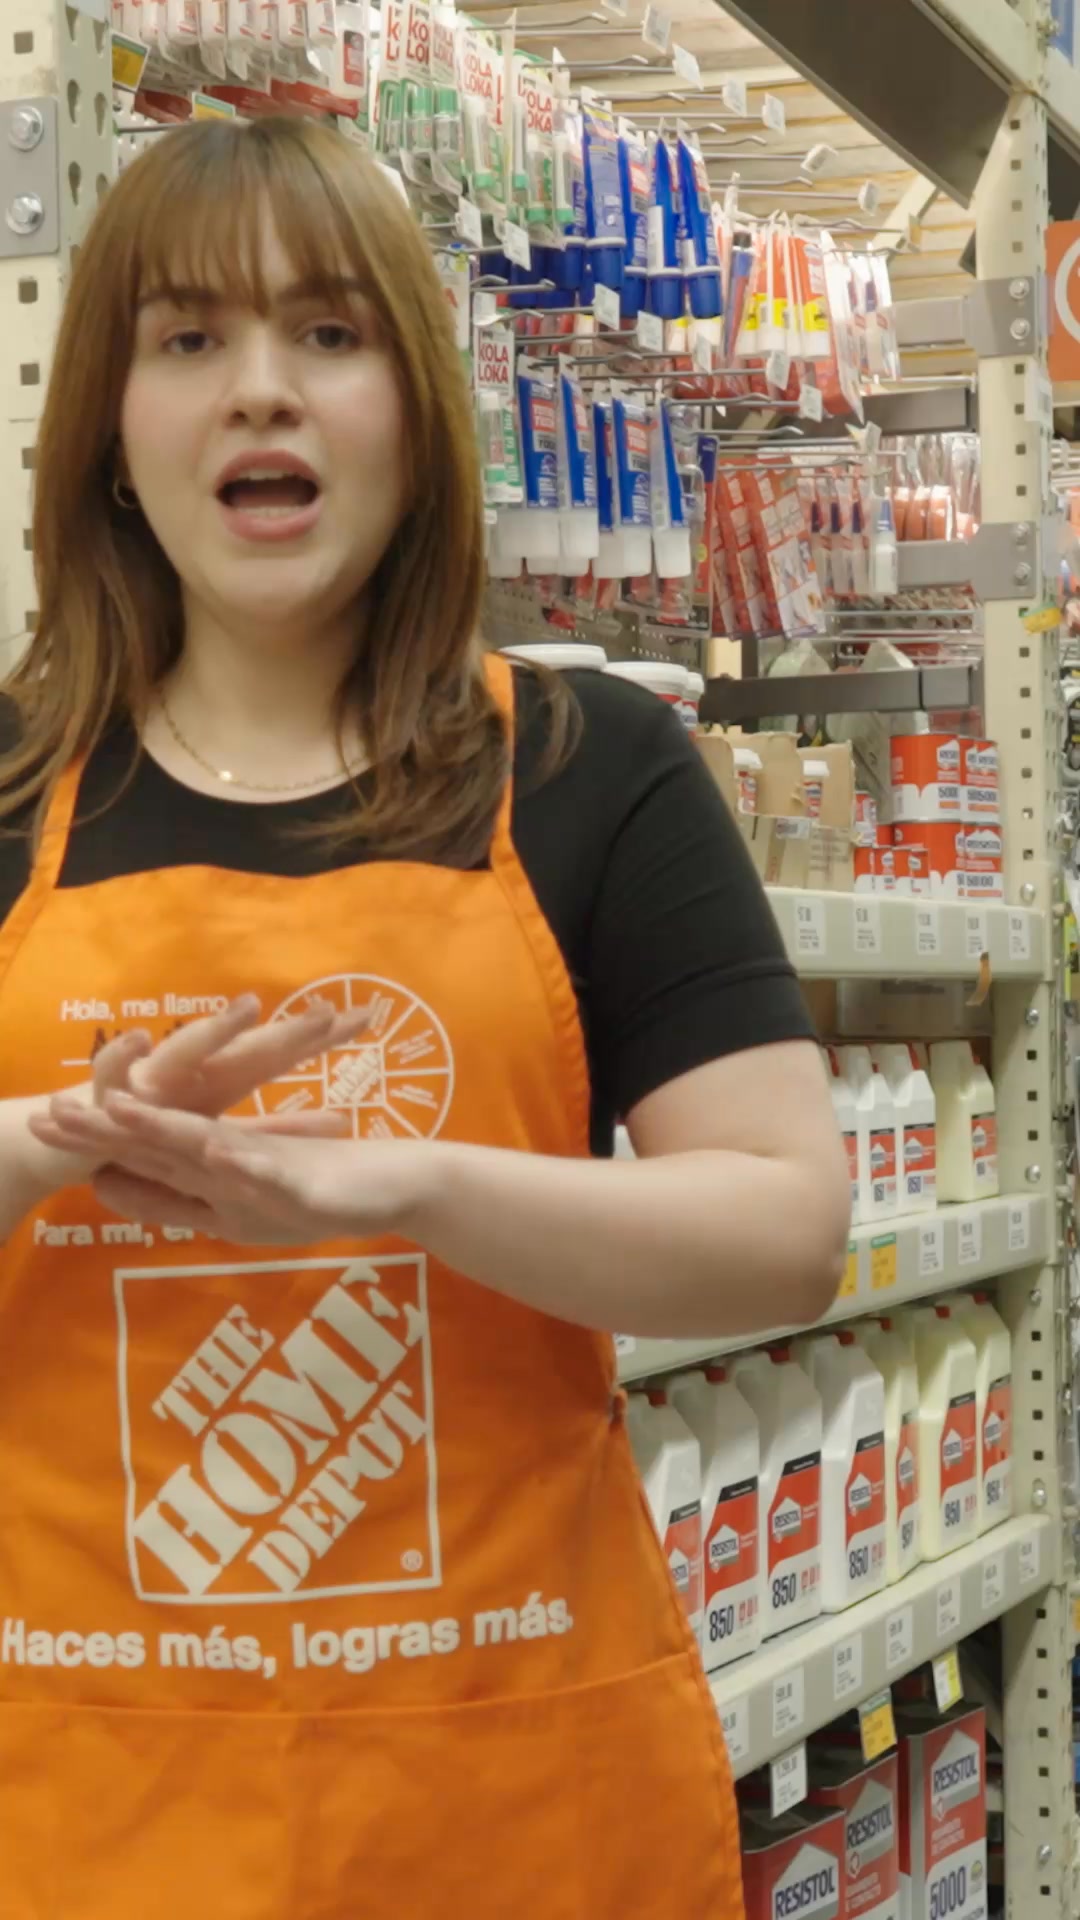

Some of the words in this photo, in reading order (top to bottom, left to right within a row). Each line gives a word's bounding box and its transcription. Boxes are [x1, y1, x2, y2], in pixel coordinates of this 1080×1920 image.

[527, 110, 552, 134] OKA
[478, 337, 509, 364] KOLA
[478, 363, 509, 384] LOKA
[60, 998, 116, 1022] Hola,
[122, 998, 159, 1018] me
[164, 993, 229, 1016] llamo
[34, 1218, 93, 1246] Para
[151, 1304, 275, 1437] THE
[132, 1262, 426, 1596] HOME
[246, 1380, 429, 1596] DEPOT
[711, 1538, 738, 1558] RESISTOL
[849, 1546, 869, 1580] 850
[772, 1572, 796, 1609] 850
[2, 1617, 146, 1667] Haces
[709, 1604, 734, 1643] 850
[159, 1625, 277, 1679] más,
[292, 1617, 460, 1673] logras
[933, 1754, 978, 1792] RESISTOL
[846, 1803, 893, 1848] RESISTOL
[774, 1864, 836, 1919] RESISTOL
[930, 1865, 967, 1920] 5000
